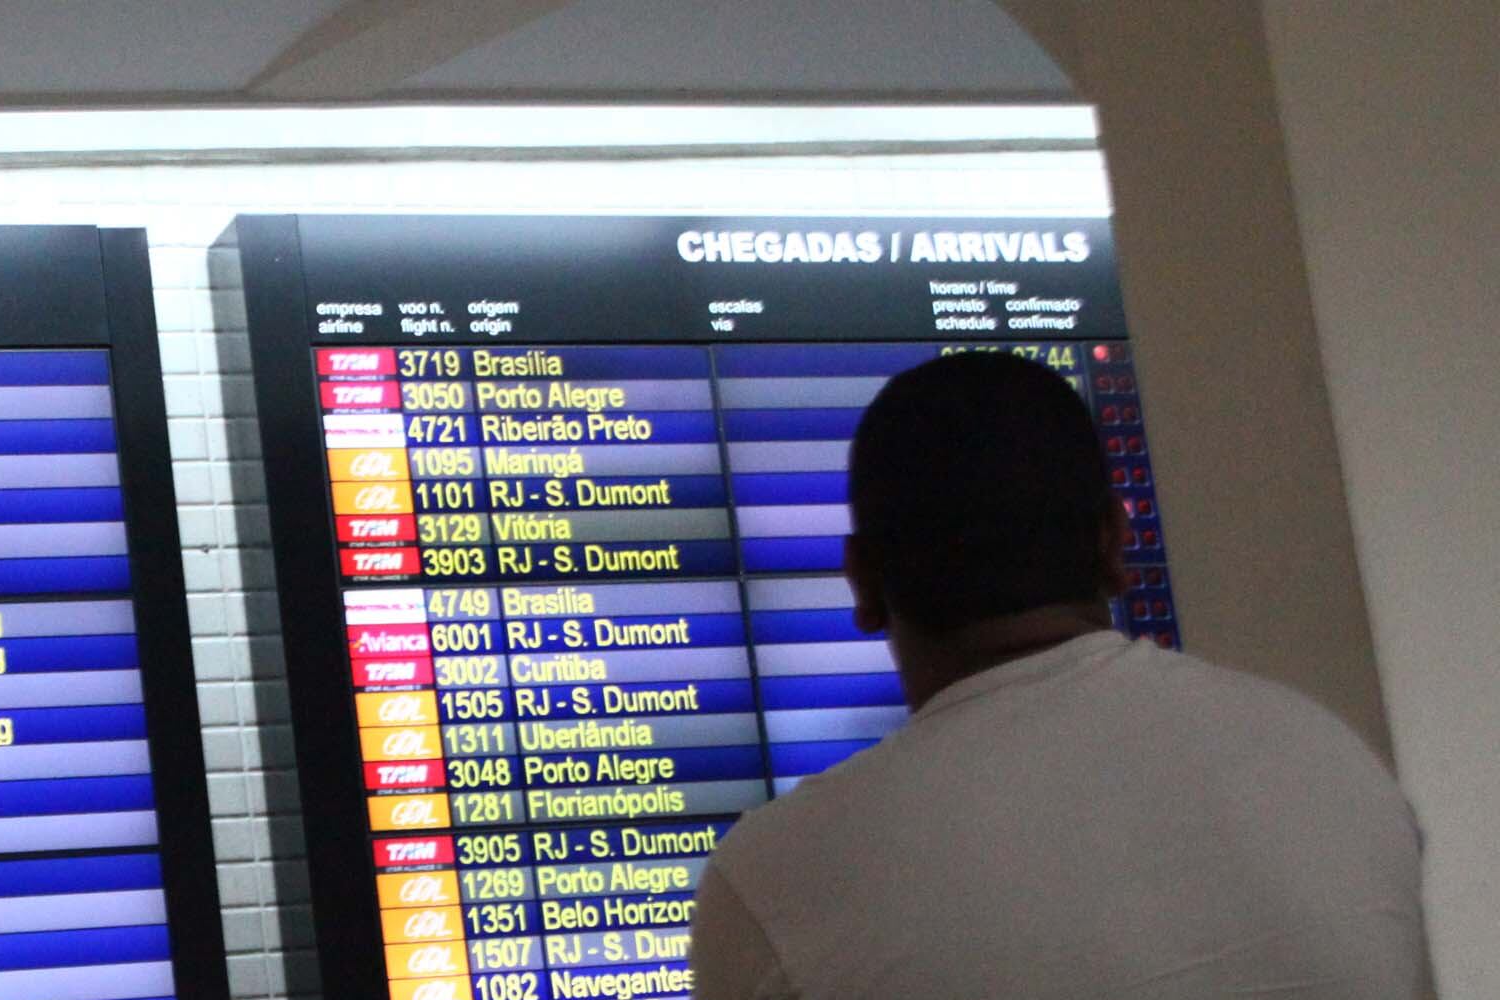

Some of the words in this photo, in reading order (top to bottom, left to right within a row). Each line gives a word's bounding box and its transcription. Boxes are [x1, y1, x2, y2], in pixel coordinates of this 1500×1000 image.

[677, 231, 882, 262] CHEGADAS
[890, 232, 898, 262] /
[911, 231, 1091, 262] ARRIVALS
[986, 281, 1017, 294] time
[316, 303, 382, 316] empresa
[398, 303, 427, 314] voo
[468, 300, 519, 317] origem
[709, 300, 763, 313] escalas
[933, 299, 987, 314] previsto
[1006, 297, 1081, 311] confirmado
[319, 320, 364, 333] airline
[401, 318, 438, 336] flight
[470, 318, 511, 335] origin
[711, 318, 734, 331] via
[936, 316, 996, 330] schedule
[1008, 314, 1075, 329] confirmed
[401, 350, 460, 376] 3719
[474, 350, 563, 376] Brasília
[404, 382, 465, 409] 3050
[477, 382, 543, 409] Porto
[548, 381, 624, 409] Alegre
[410, 416, 464, 442] 4721
[483, 415, 582, 440] Ribeirão
[588, 416, 651, 439] Preto
[414, 448, 474, 475] 1095
[486, 448, 585, 478] Maringá
[418, 482, 474, 508] 1101
[490, 481, 523, 507] RJ
[576, 479, 670, 506] Dumont
[418, 514, 483, 544] 3129
[492, 512, 575, 541] Vitória
[423, 548, 486, 575] 3903
[498, 547, 532, 573] RJ
[585, 545, 679, 571] Dumont
[503, 587, 594, 615] Brasília
[433, 624, 490, 650] 6001
[508, 622, 541, 647] RJ
[595, 620, 688, 646] Dumont
[512, 655, 606, 682] Curitiba
[444, 691, 503, 718] 1505
[516, 690, 549, 714] RJ
[604, 686, 697, 712] Dumont
[444, 725, 505, 753] 1311
[519, 723, 654, 751] Uberlândia
[448, 758, 511, 788] 3048
[524, 757, 590, 784] Porto
[597, 754, 674, 784] Alegre
[453, 792, 514, 822] 1281
[527, 790, 686, 819] Florianópolis
[458, 834, 521, 864] 3905
[534, 832, 568, 859] RJ
[622, 828, 717, 856] Dumont
[463, 868, 526, 899] 1269
[537, 866, 605, 895] Porto
[610, 863, 690, 893] Alegre
[468, 904, 526, 933] 1351
[542, 901, 599, 929] Belo
